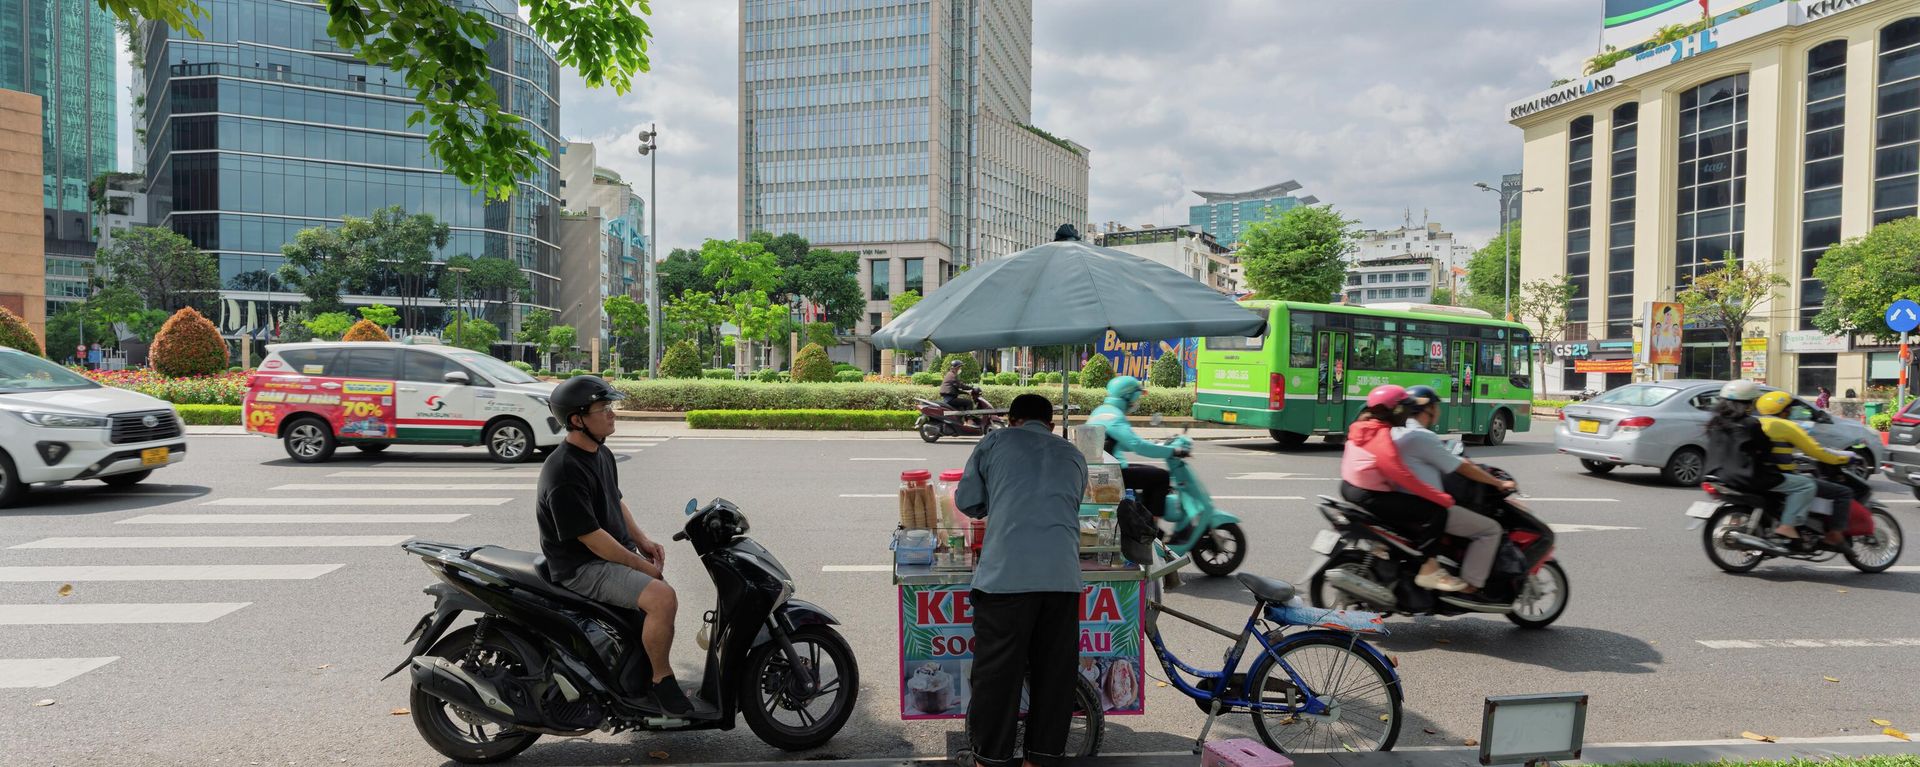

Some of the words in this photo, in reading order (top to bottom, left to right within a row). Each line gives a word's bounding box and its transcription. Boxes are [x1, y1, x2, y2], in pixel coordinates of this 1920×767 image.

[1510, 99, 1538, 117] KHAI
[1541, 87, 1577, 107] HOAN
[1580, 75, 1614, 95] LAND
[1432, 344, 1441, 356] 03
[1554, 343, 1588, 356] GS25
[341, 401, 383, 417] 70%
[917, 591, 974, 624] KE
[1079, 629, 1111, 651] ÂU
